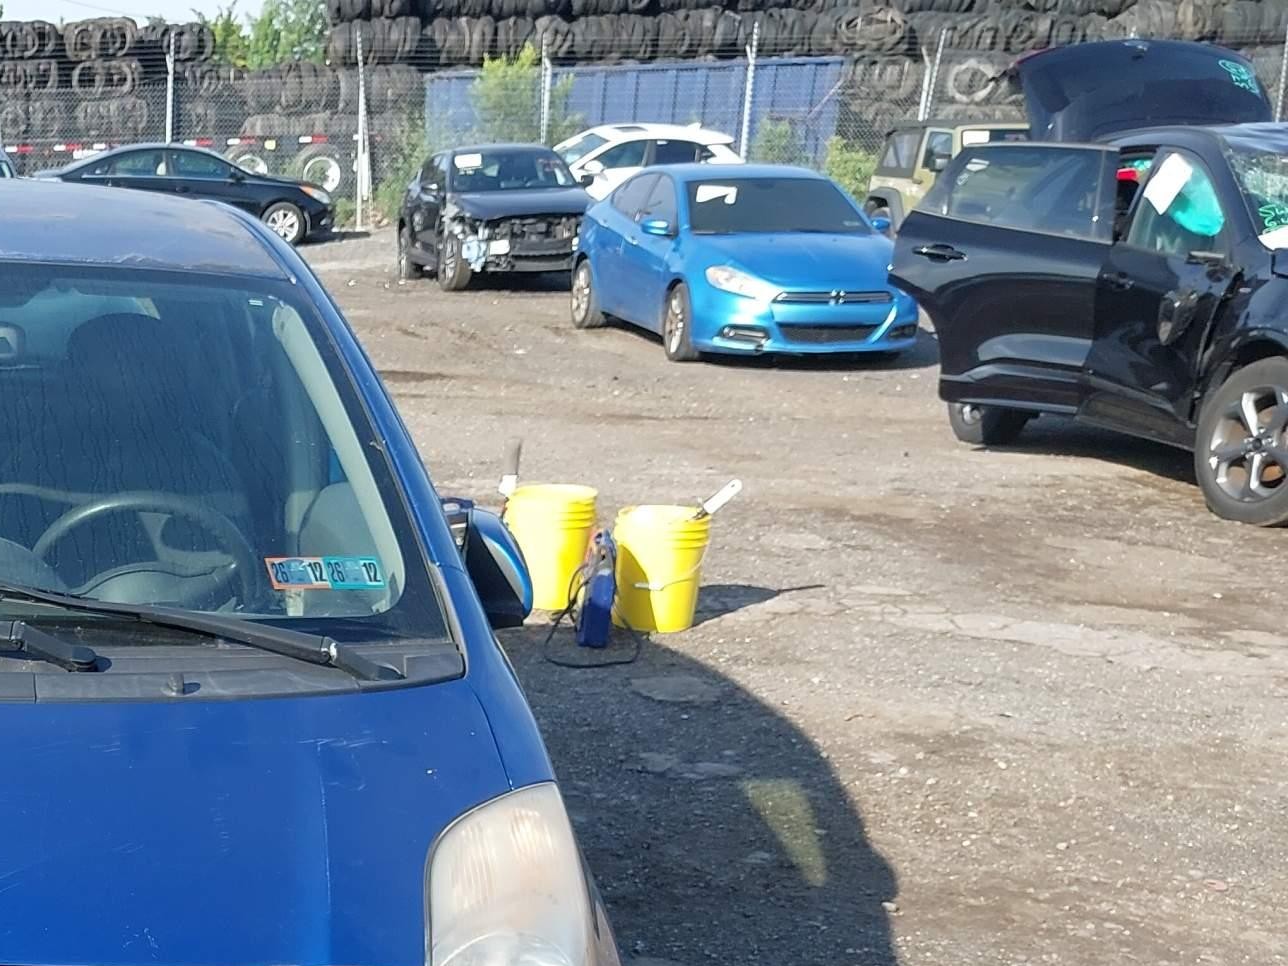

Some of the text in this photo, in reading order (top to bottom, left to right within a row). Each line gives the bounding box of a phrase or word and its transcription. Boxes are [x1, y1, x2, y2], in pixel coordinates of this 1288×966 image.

[271, 561, 328, 583] 26 12
[327, 561, 381, 582] 26 12
